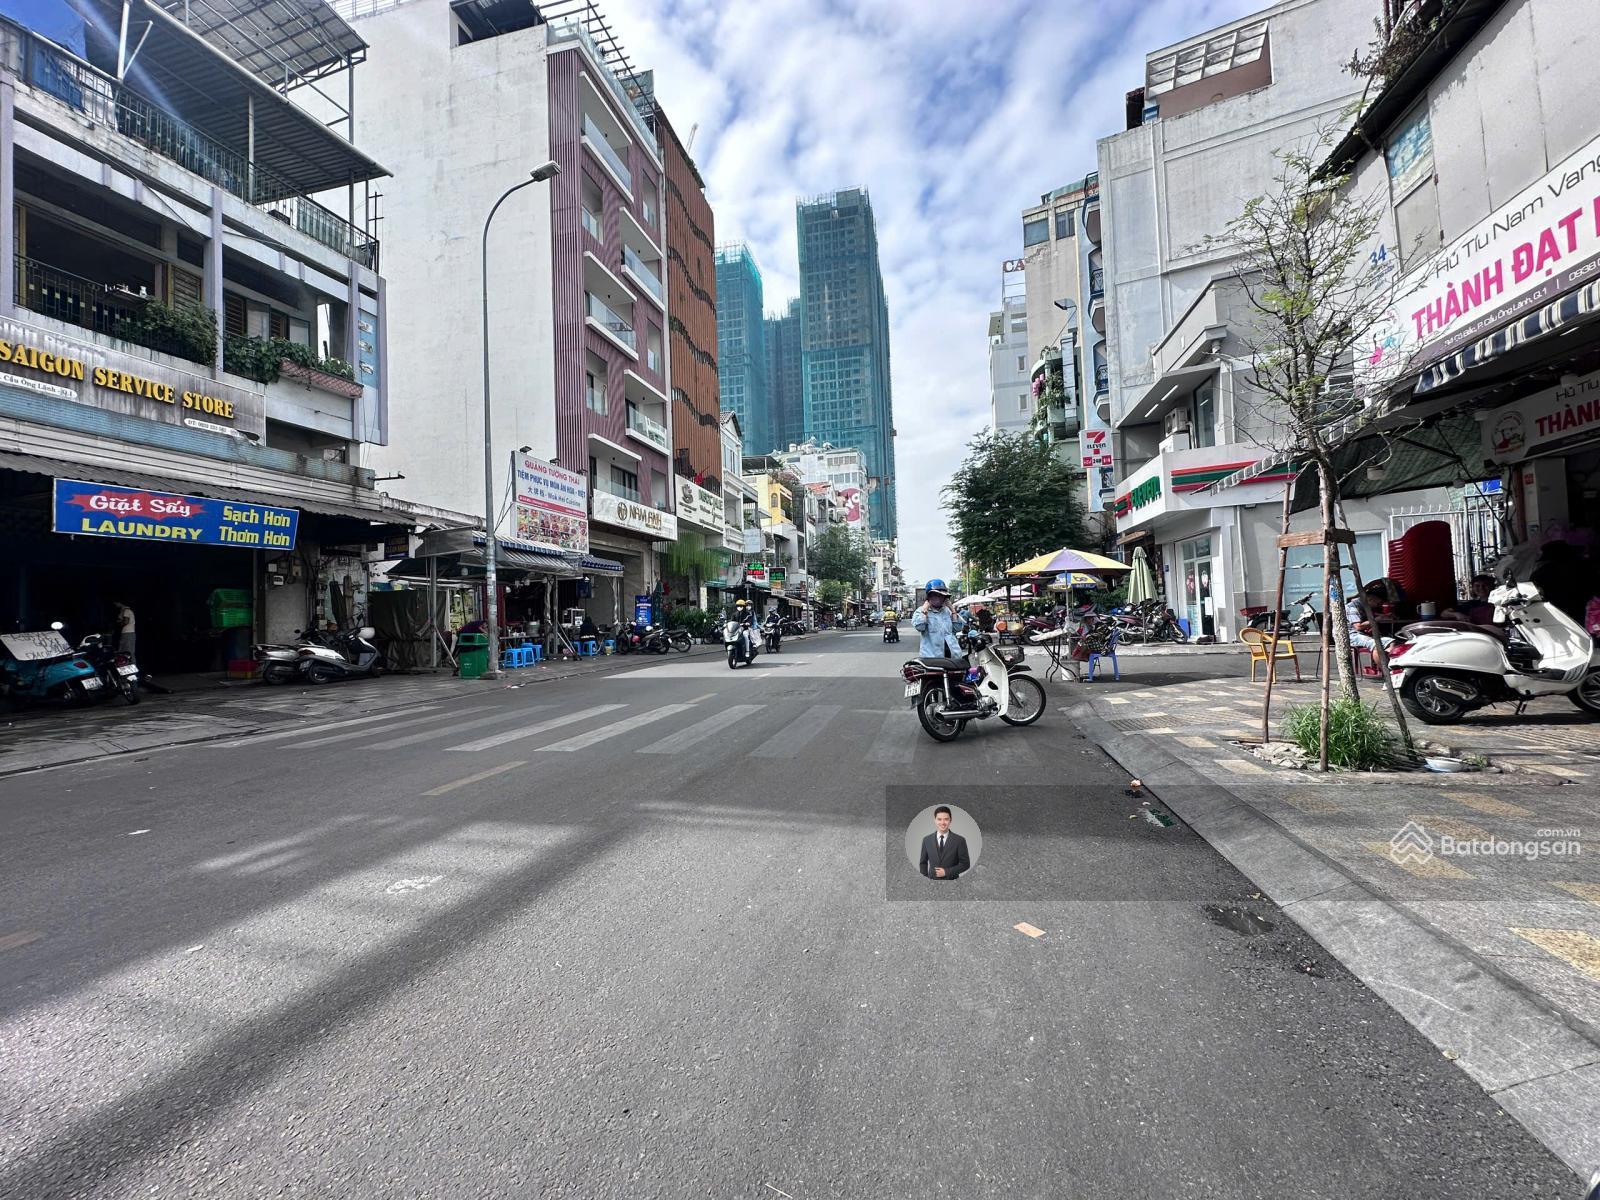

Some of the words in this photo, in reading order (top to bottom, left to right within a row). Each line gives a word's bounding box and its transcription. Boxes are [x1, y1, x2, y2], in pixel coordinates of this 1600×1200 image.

[1493, 196, 1544, 240] Nam
[1547, 154, 1600, 198] Van
[1412, 257, 1505, 339] THÀNH
[1511, 207, 1583, 285] ĐẠT
[0, 338, 85, 381] SAIGON
[94, 366, 175, 404] SERVICE
[182, 391, 234, 419] STORE
[1086, 431, 1106, 455] 7
[89, 494, 143, 514] Giặt
[150, 499, 191, 517] Sấy
[222, 505, 260, 526] Sạch
[264, 510, 291, 528] Hơn
[82, 518, 203, 540] LAUNDRY
[219, 526, 260, 545] Thơm
[263, 531, 291, 547] Hơn
